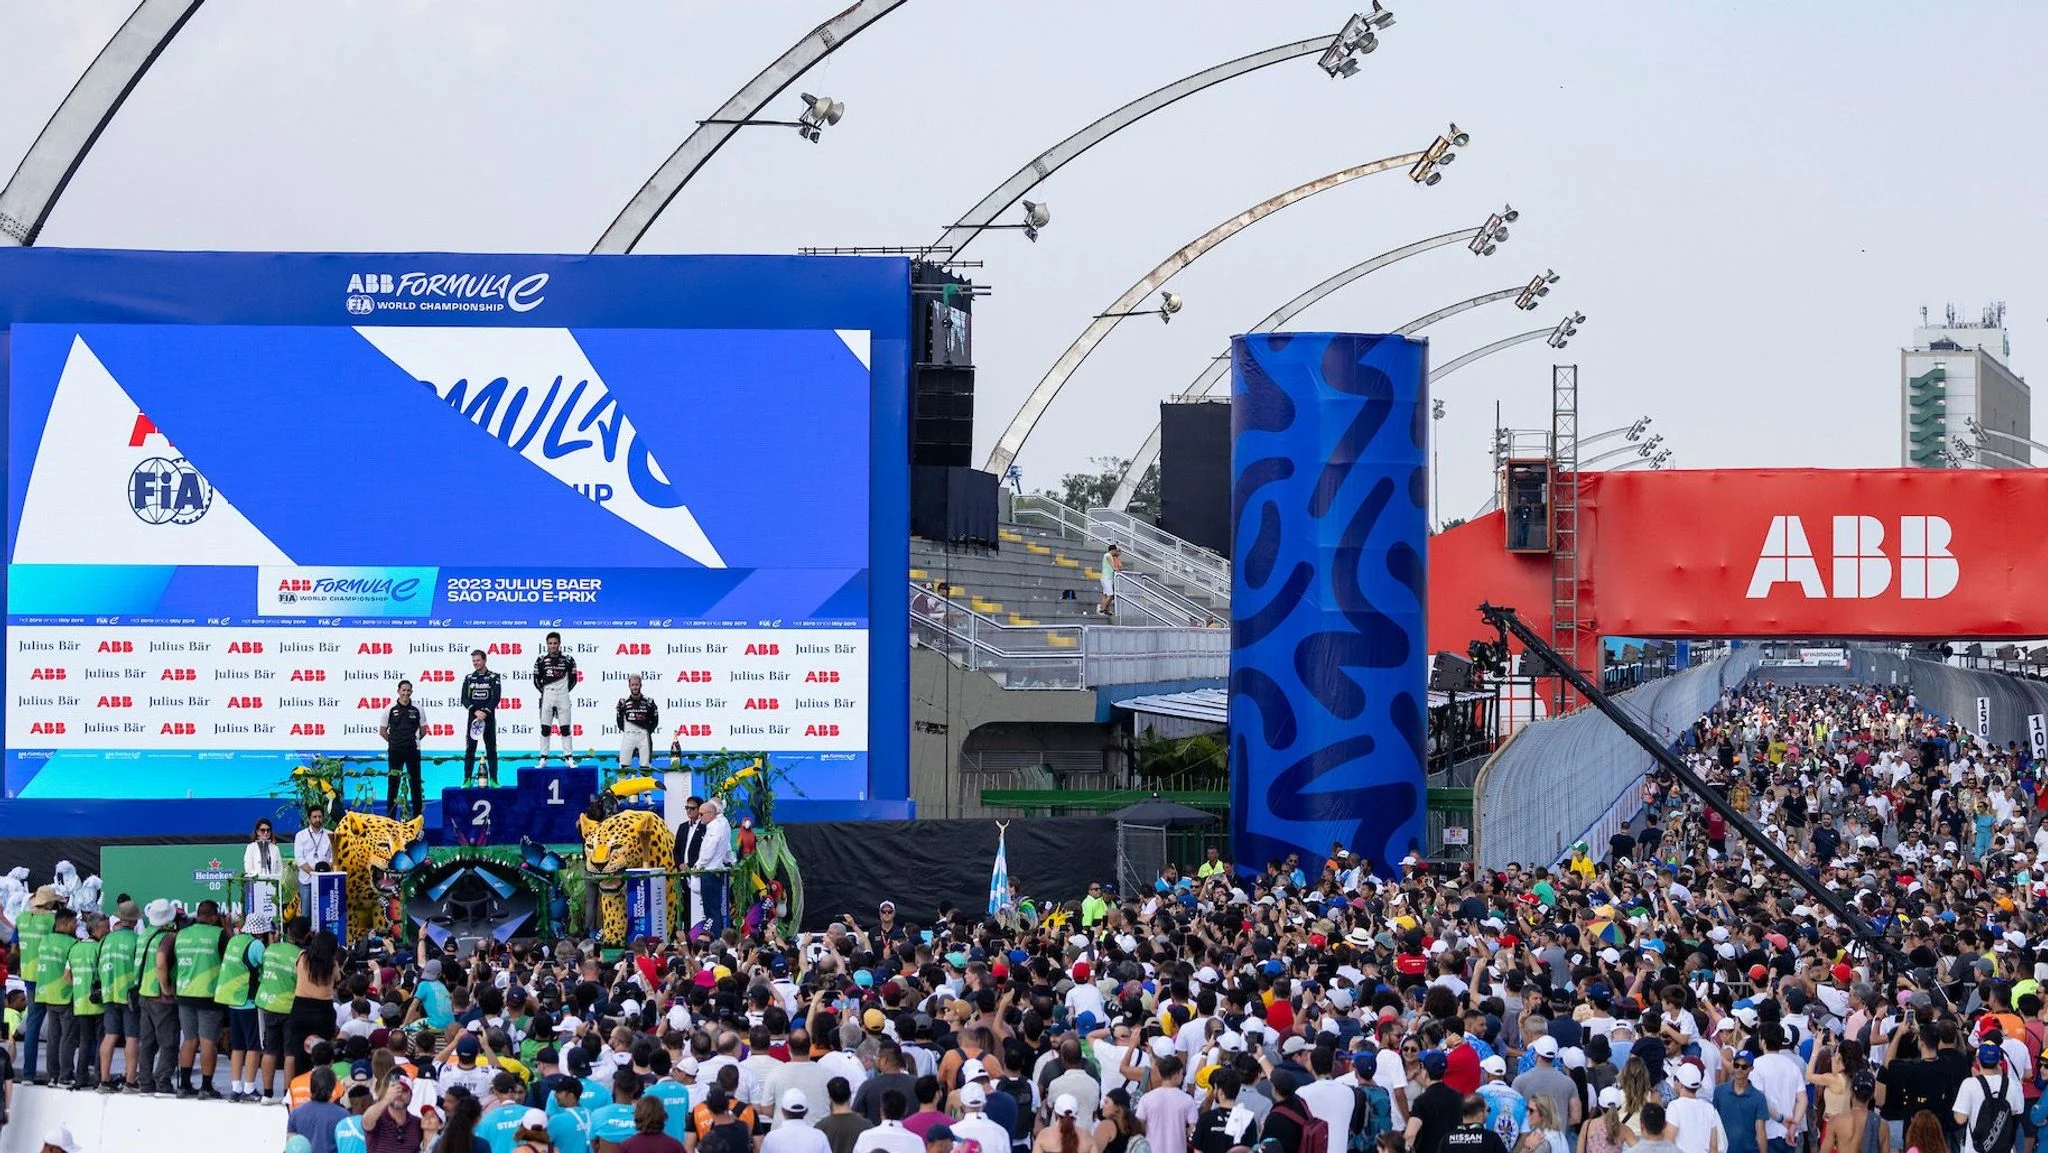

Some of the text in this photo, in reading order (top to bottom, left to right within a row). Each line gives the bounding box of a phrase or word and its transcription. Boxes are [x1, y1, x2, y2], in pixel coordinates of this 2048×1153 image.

[347, 273, 394, 294] ABB
[396, 272, 512, 299] FORMULA
[377, 301, 416, 311] WORLD
[420, 302, 504, 312] CHAMPIONSHIP
[1745, 515, 1960, 599] ABB
[279, 579, 311, 591] ABB
[313, 578, 393, 594] FORMULA
[447, 578, 602, 590] 2023 JULIUS BAER
[485, 591, 540, 602] PAULO
[542, 591, 597, 602] E-PRIX
[20, 641, 80, 652] Julius Bär
[98, 641, 133, 654] ABB
[150, 642, 211, 653] Julius Bär
[228, 642, 263, 654] ABB
[280, 642, 341, 654] Julius Bär
[358, 642, 393, 655] ABB
[409, 643, 471, 654] Julius Bär
[487, 643, 522, 655] ABB
[577, 643, 599, 653] Bär
[616, 643, 651, 656] ABB
[667, 643, 728, 655] Julius Bär
[745, 643, 780, 656] ABB
[795, 643, 857, 655] Julius Bär
[31, 668, 66, 681] ABB
[85, 669, 146, 680] Julius Bär
[161, 669, 196, 682] ABB
[215, 669, 276, 681] Julius Bär
[291, 670, 326, 682] ABB
[344, 670, 406, 681] Julius Bär
[420, 670, 455, 682] ABB
[641, 671, 662, 680] Bär
[677, 671, 712, 683] ABB
[730, 671, 791, 682] Julius Bär
[805, 671, 840, 683] ABB
[19, 696, 80, 707] Julius Bär
[97, 696, 132, 709] ABB
[149, 697, 211, 708] Julius Bär
[227, 697, 262, 710] ABB
[279, 697, 340, 709] Julius Bär
[449, 698, 463, 707] Bä
[496, 698, 522, 710] BB
[577, 698, 599, 708] Bär
[667, 698, 727, 710] Julius Bär
[744, 698, 779, 711] ABB
[795, 698, 856, 710] Julius Bär
[1980, 699, 1988, 735] 150
[31, 722, 66, 735] ABB
[84, 723, 146, 734] Julius Bär
[161, 723, 196, 736] ABB
[214, 723, 275, 735] Julius Bär
[290, 724, 325, 736] ABB
[344, 724, 378, 735] Julius
[512, 724, 534, 734] Bär
[677, 725, 712, 737] ABB
[730, 725, 790, 736] Julius Bär
[805, 725, 840, 737] ABB
[547, 779, 565, 805] 1
[472, 800, 492, 826] 2
[664, 1097, 686, 1106] STAFF
[1449, 1133, 1483, 1141] NISSAN
